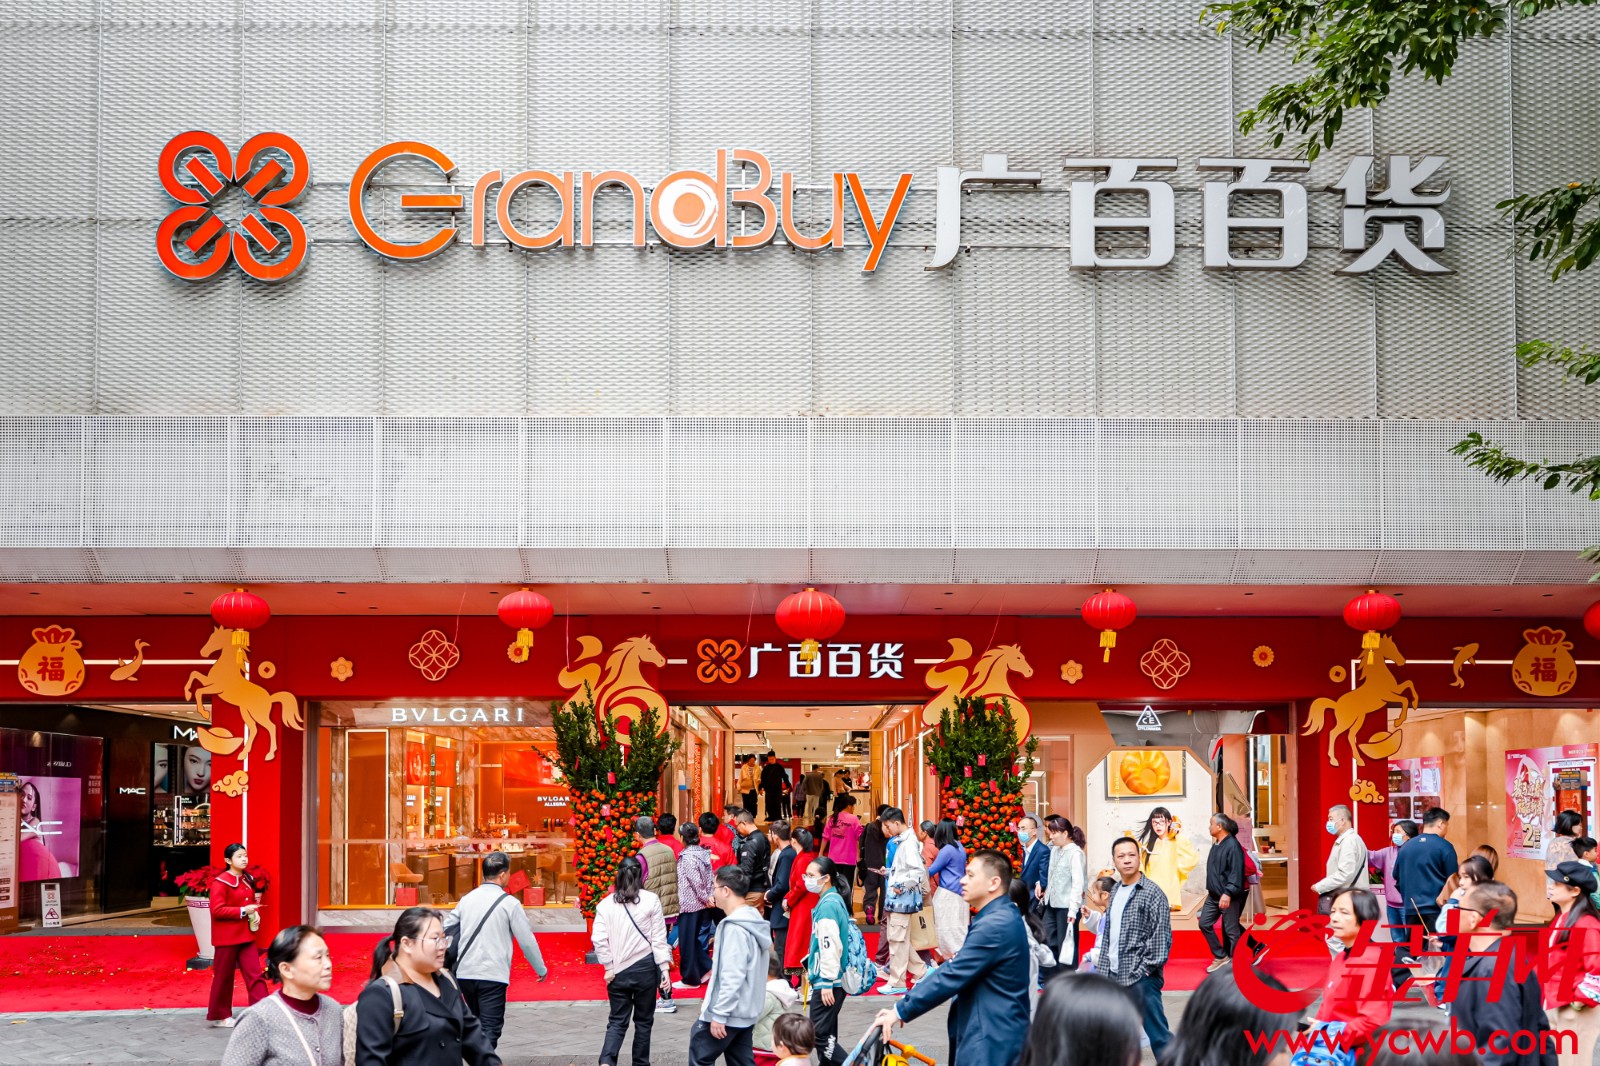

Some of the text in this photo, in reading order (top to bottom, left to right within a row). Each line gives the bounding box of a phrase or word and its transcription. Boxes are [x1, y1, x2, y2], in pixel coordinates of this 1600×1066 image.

[347, 140, 913, 274] GrandBuy
[925, 153, 1457, 276] 广百百货
[36, 655, 65, 682] 福
[747, 642, 905, 679] 广百百货
[1529, 656, 1558, 682] 福
[391, 707, 524, 722] BVLGARI
[119, 787, 146, 795] MAC
[823, 936, 830, 949] 5
